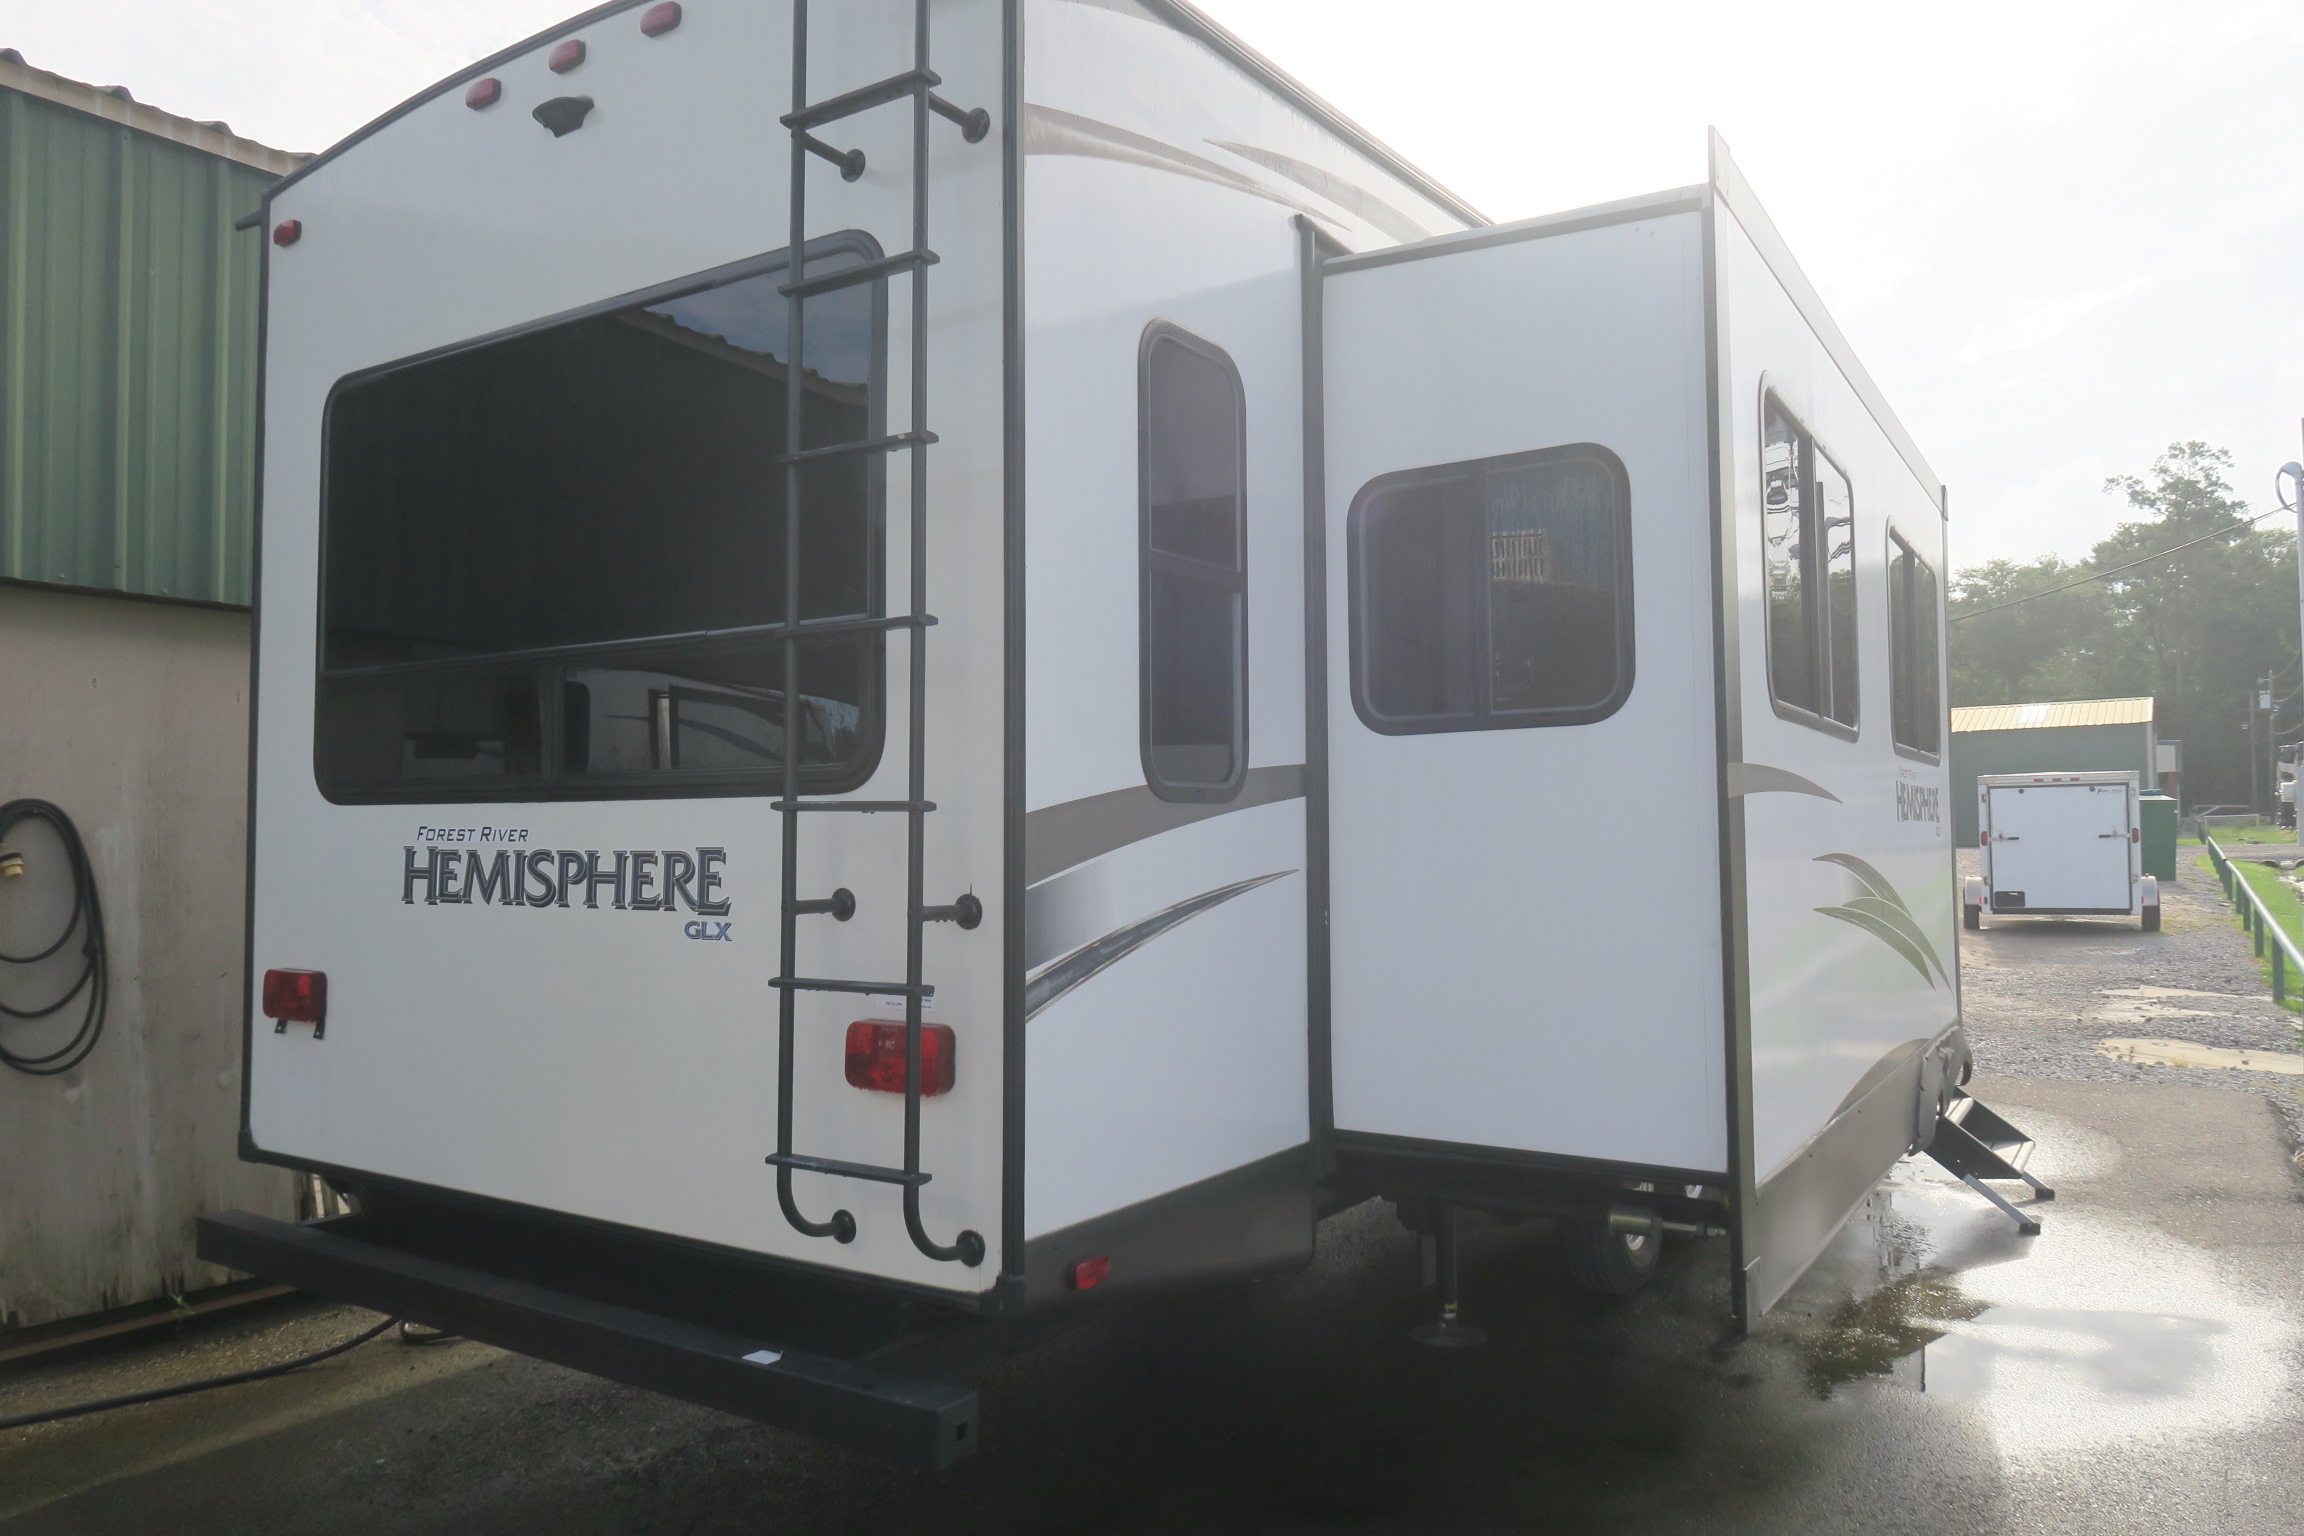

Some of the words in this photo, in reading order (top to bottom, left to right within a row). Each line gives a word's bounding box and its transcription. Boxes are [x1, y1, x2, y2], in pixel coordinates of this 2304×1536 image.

[417, 826, 475, 842] FOREST
[480, 826, 529, 842] RIVER
[401, 845, 732, 916] HEMISPHERE
[684, 921, 733, 942] GLX
